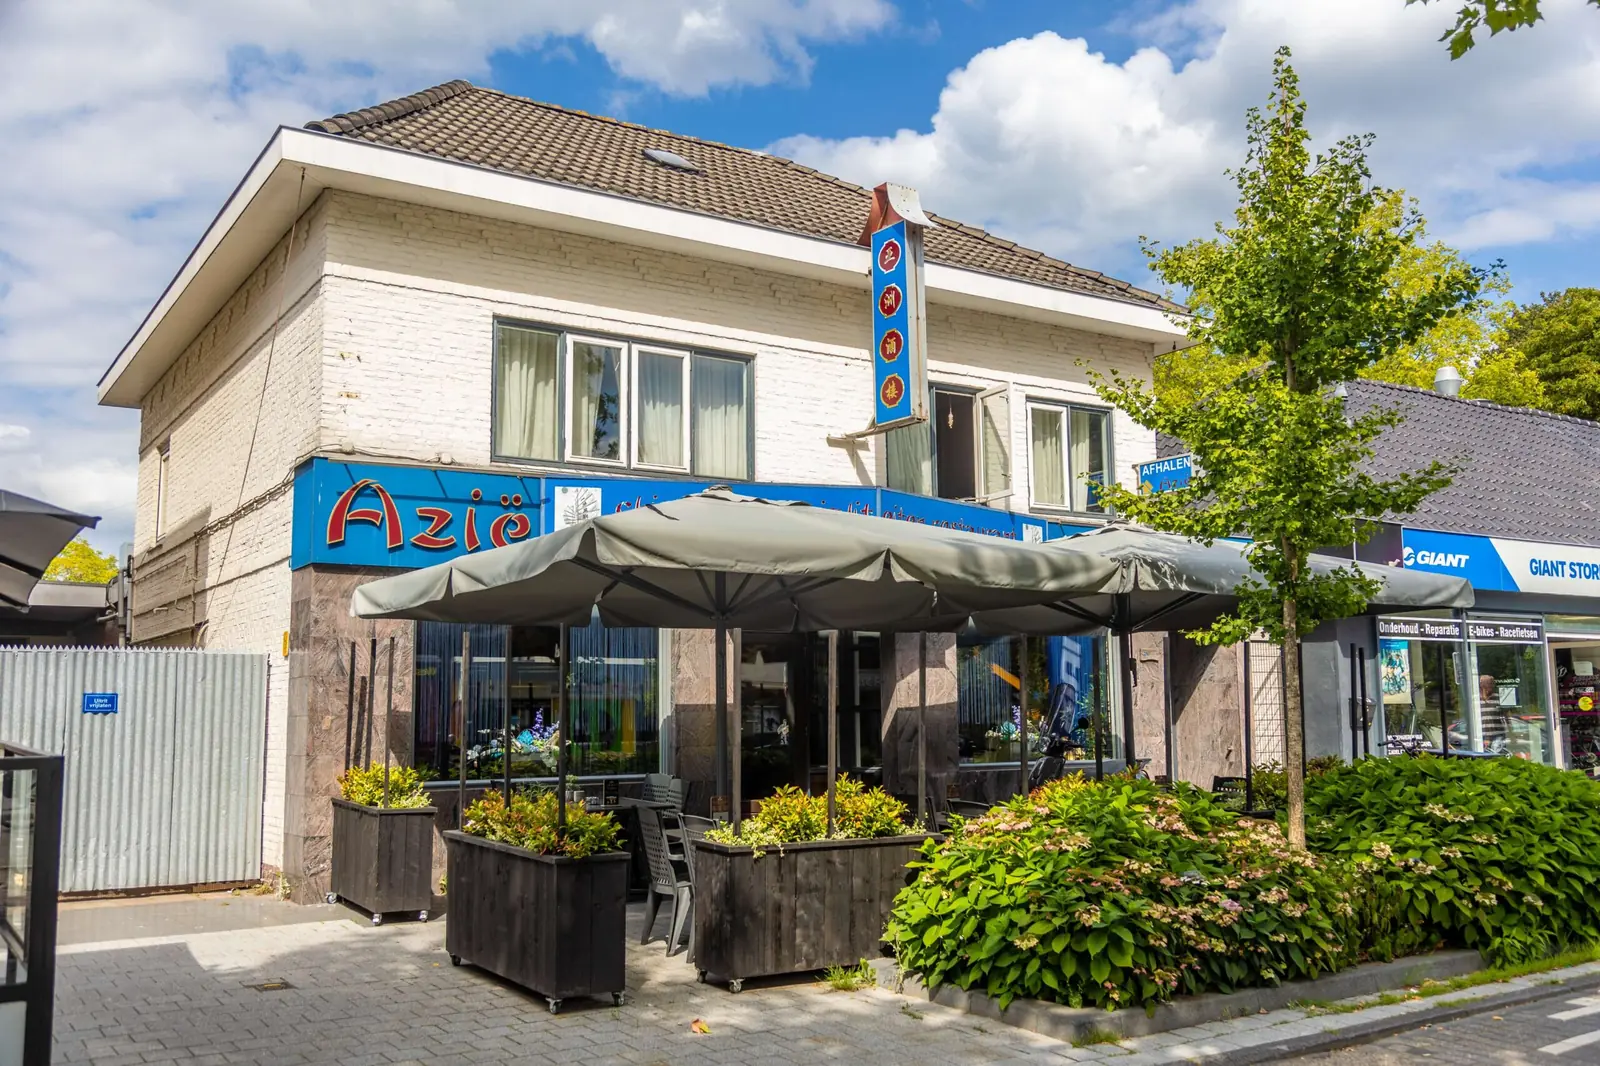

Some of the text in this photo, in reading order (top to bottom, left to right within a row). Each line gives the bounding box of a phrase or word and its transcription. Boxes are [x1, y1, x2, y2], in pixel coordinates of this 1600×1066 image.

[1142, 456, 1191, 476] AFHALEN
[326, 478, 532, 552] Azië
[1416, 550, 1470, 569] GIANT
[1529, 558, 1600, 581] GIANT STOR
[1379, 621, 1419, 634] Onderhoud
[1425, 623, 1460, 637] Reparatie
[1468, 624, 1495, 638] E-bikes
[1500, 626, 1538, 639] Racefietsen
